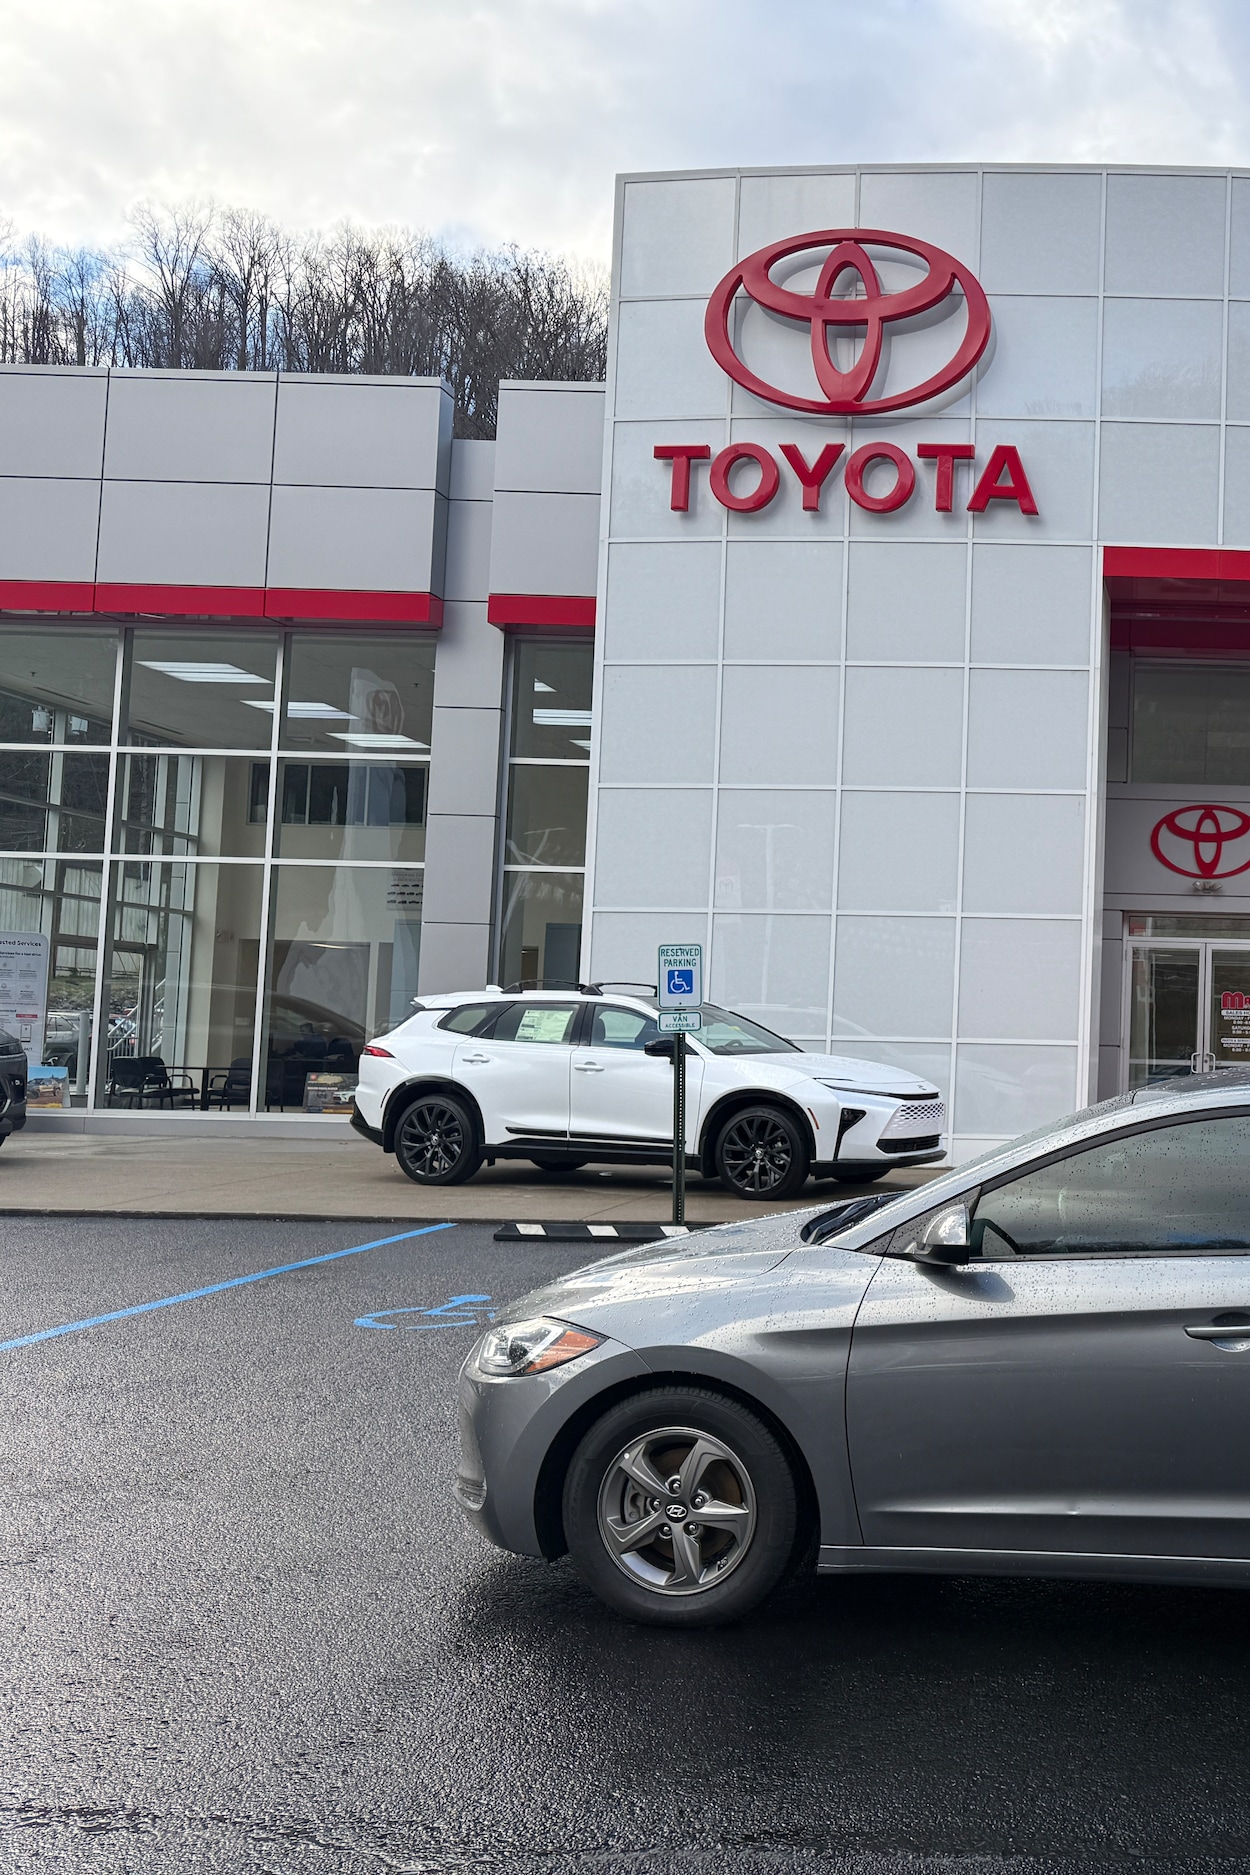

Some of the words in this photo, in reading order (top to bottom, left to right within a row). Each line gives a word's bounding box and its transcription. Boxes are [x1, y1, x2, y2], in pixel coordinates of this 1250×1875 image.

[654, 442, 1039, 516] TOYOTA
[661, 948, 700, 957] RESERVED
[664, 958, 697, 967] PARKING
